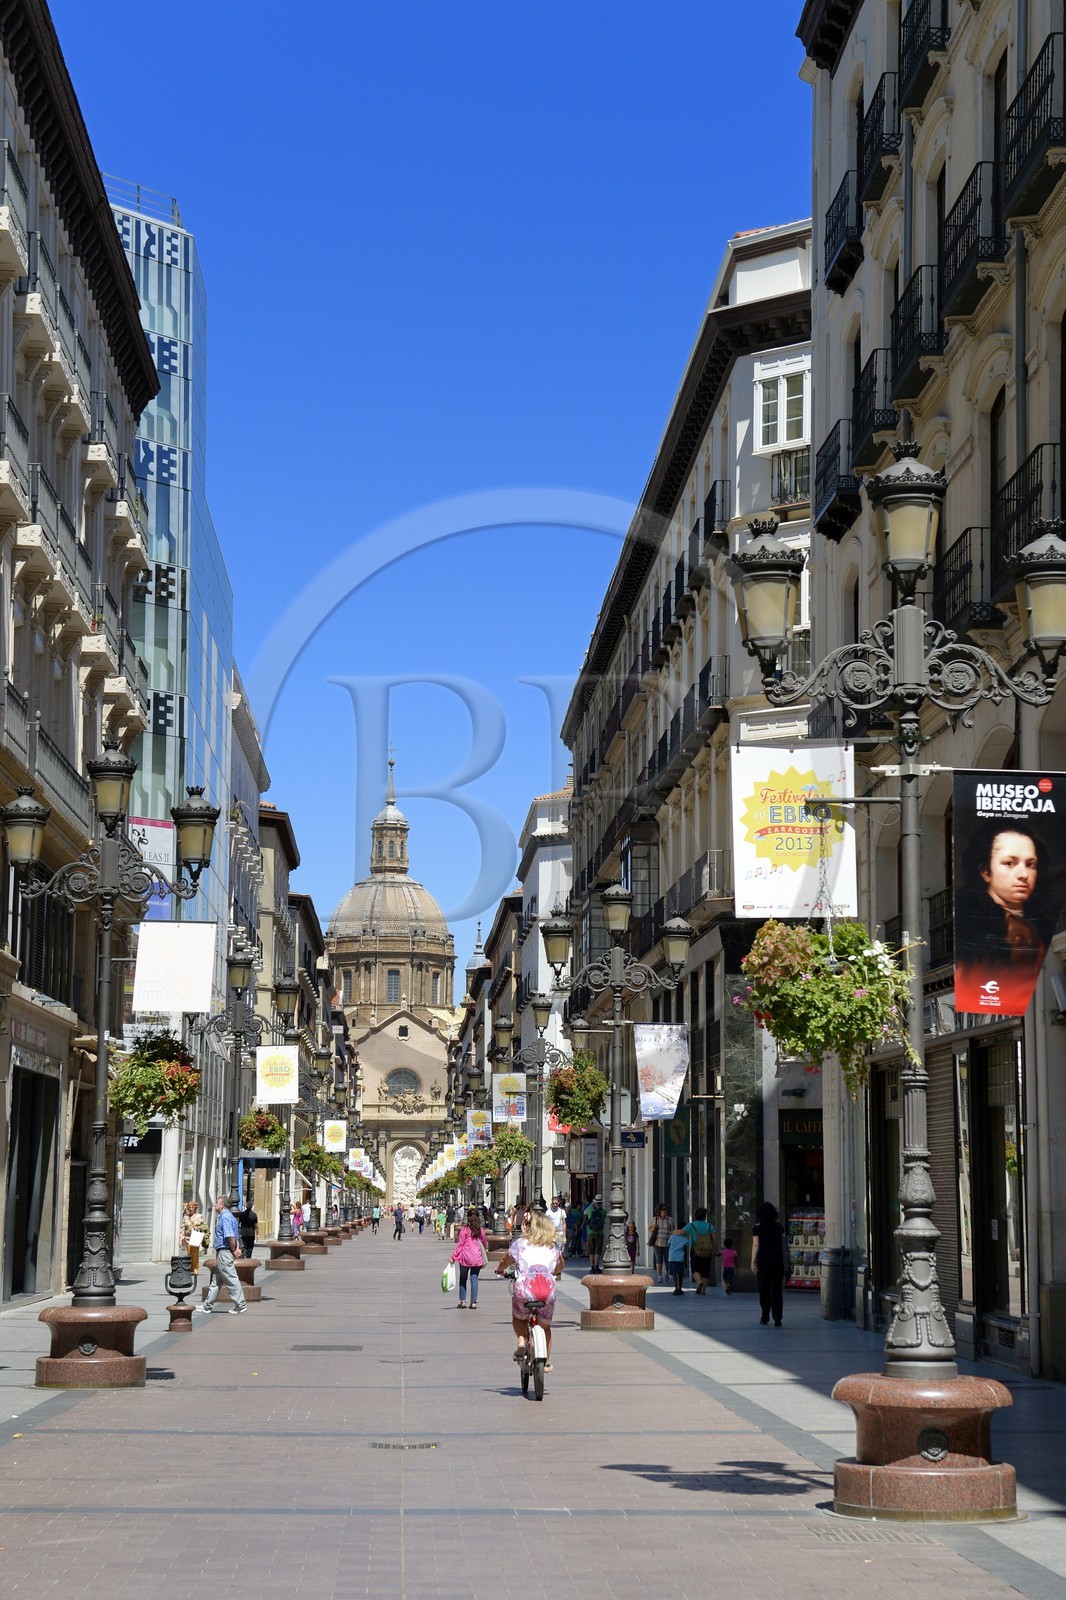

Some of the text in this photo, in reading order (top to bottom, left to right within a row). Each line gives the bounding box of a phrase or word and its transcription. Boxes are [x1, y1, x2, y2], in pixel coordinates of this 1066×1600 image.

[976, 783, 1040, 799] MUSEO
[976, 797, 1056, 813] IBERCAJA
[769, 805, 831, 823] EBRO
[775, 837, 813, 850] 2013
